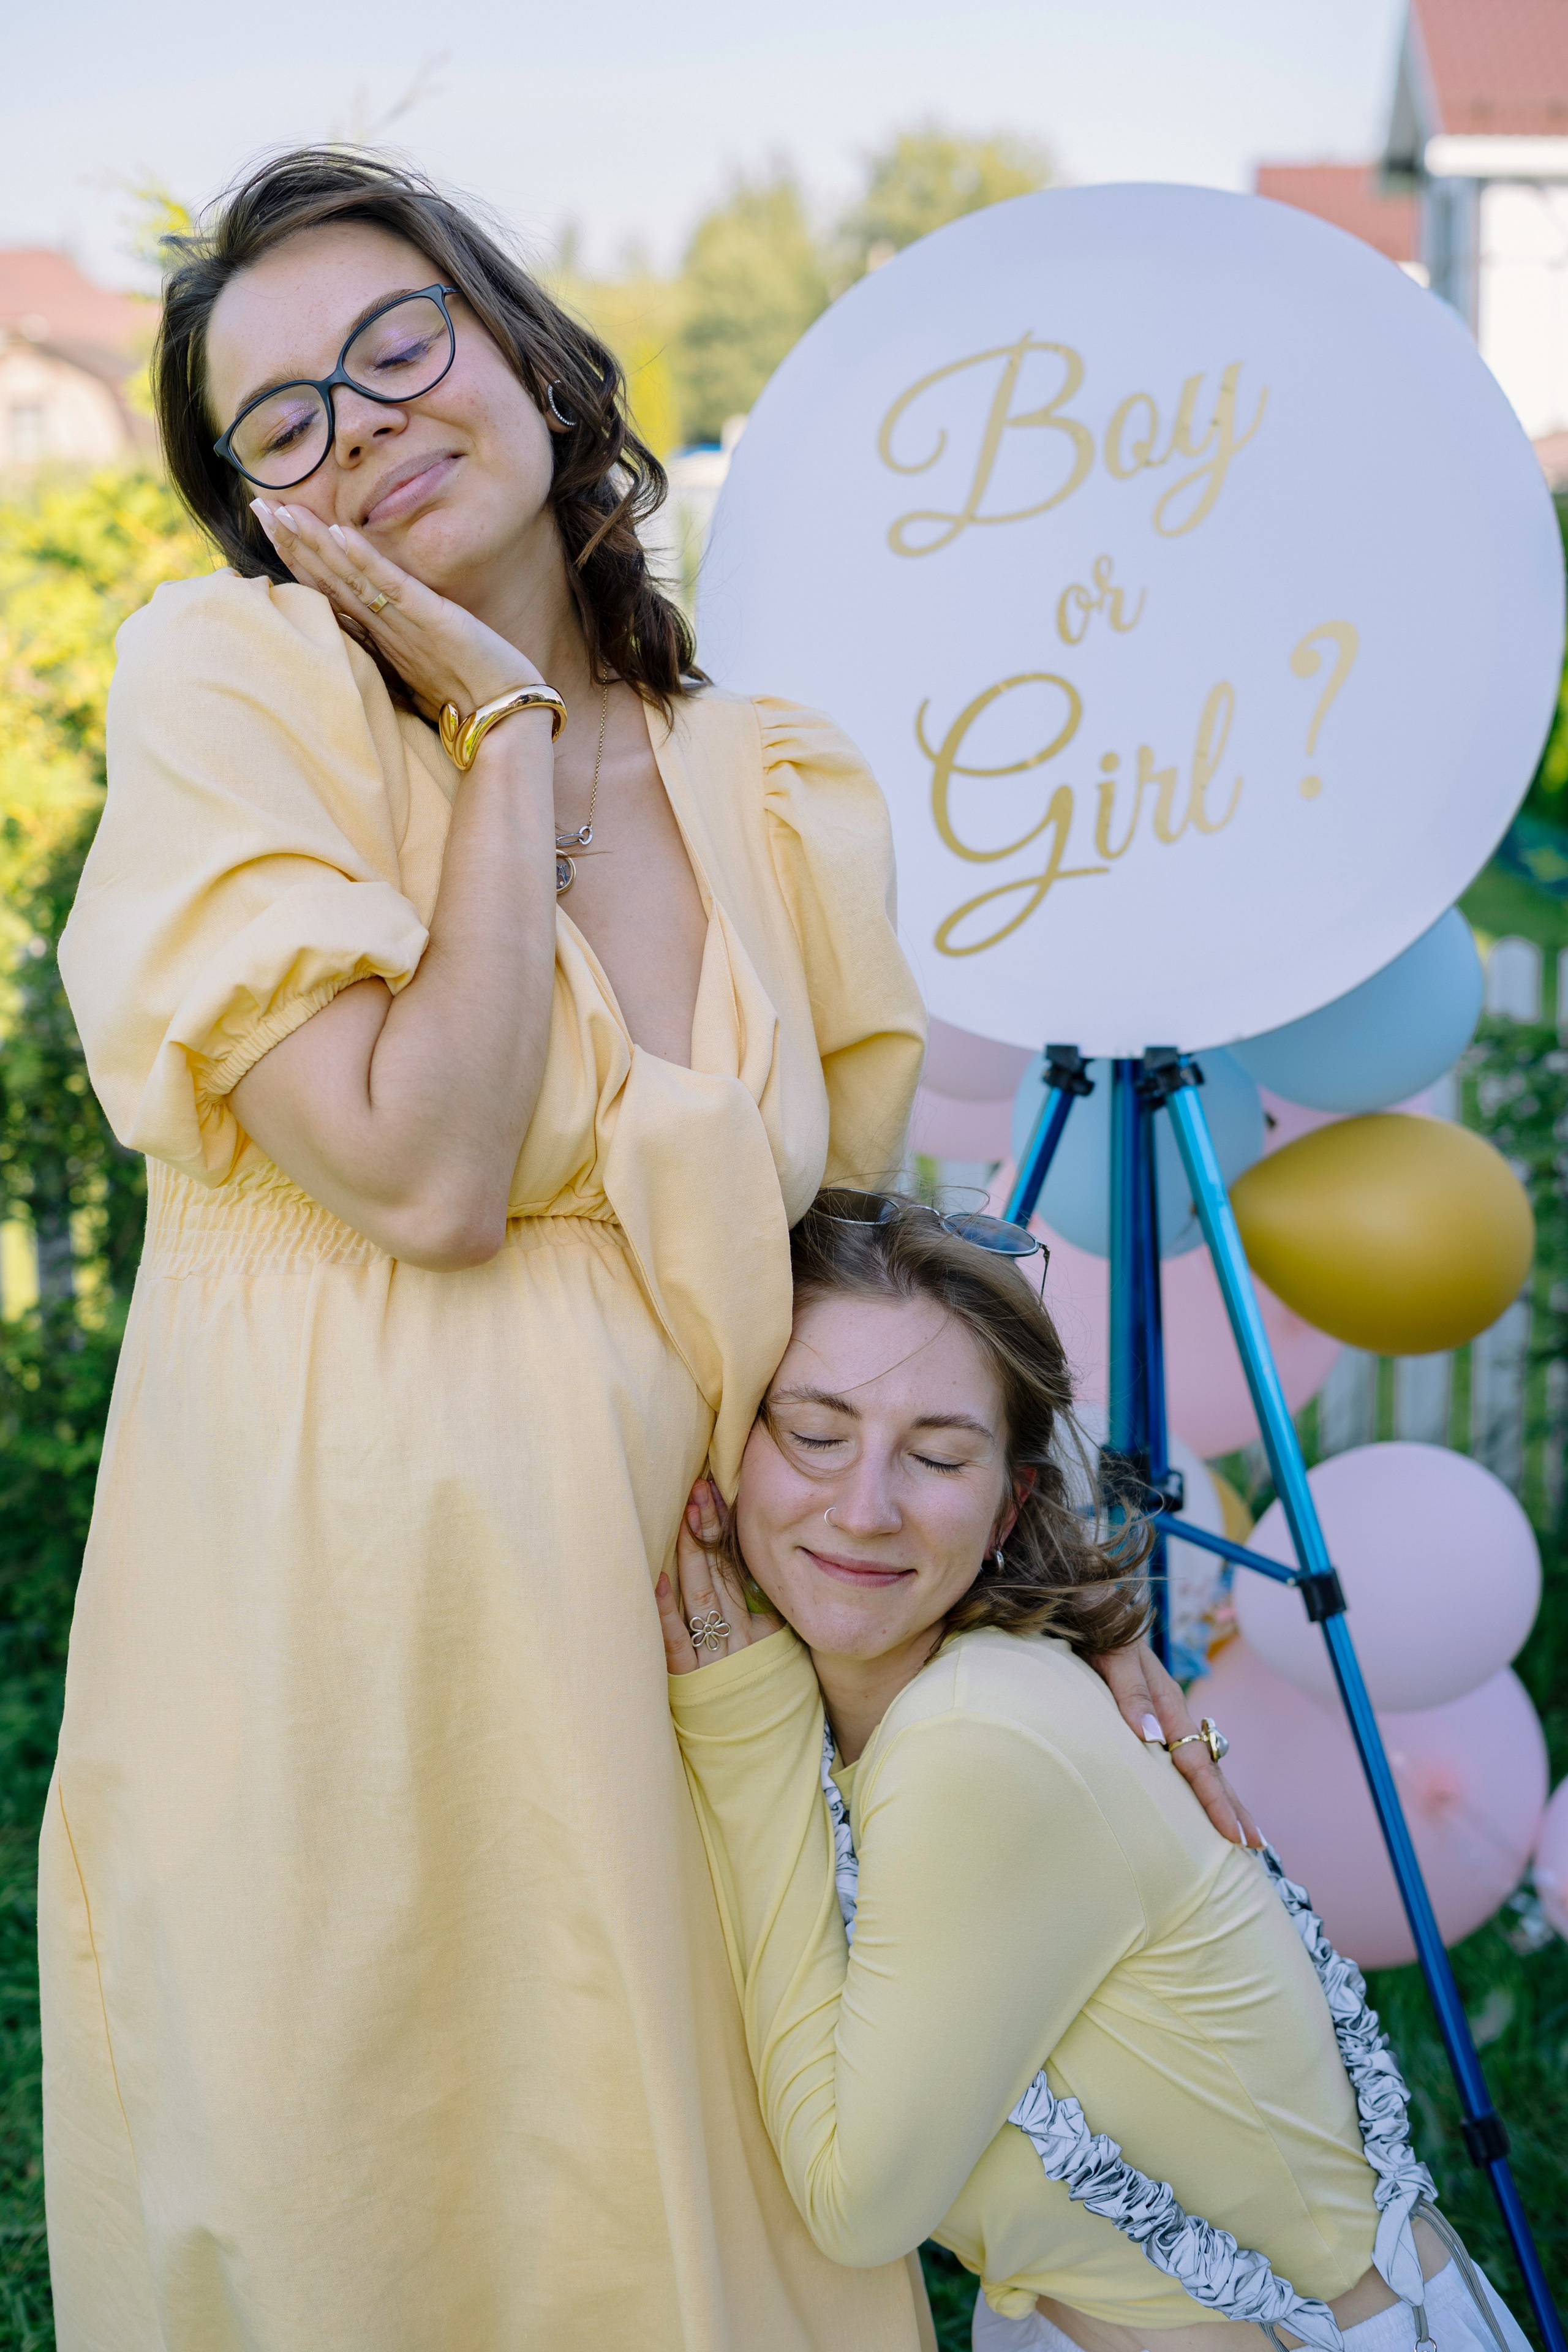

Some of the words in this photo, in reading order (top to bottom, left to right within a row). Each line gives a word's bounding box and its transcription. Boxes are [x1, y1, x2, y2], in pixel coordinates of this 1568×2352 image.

[878, 331, 1268, 557] Boy
[1057, 554, 1147, 646] or
[915, 673, 1243, 957] Girl
[1291, 620, 1359, 799] ?
